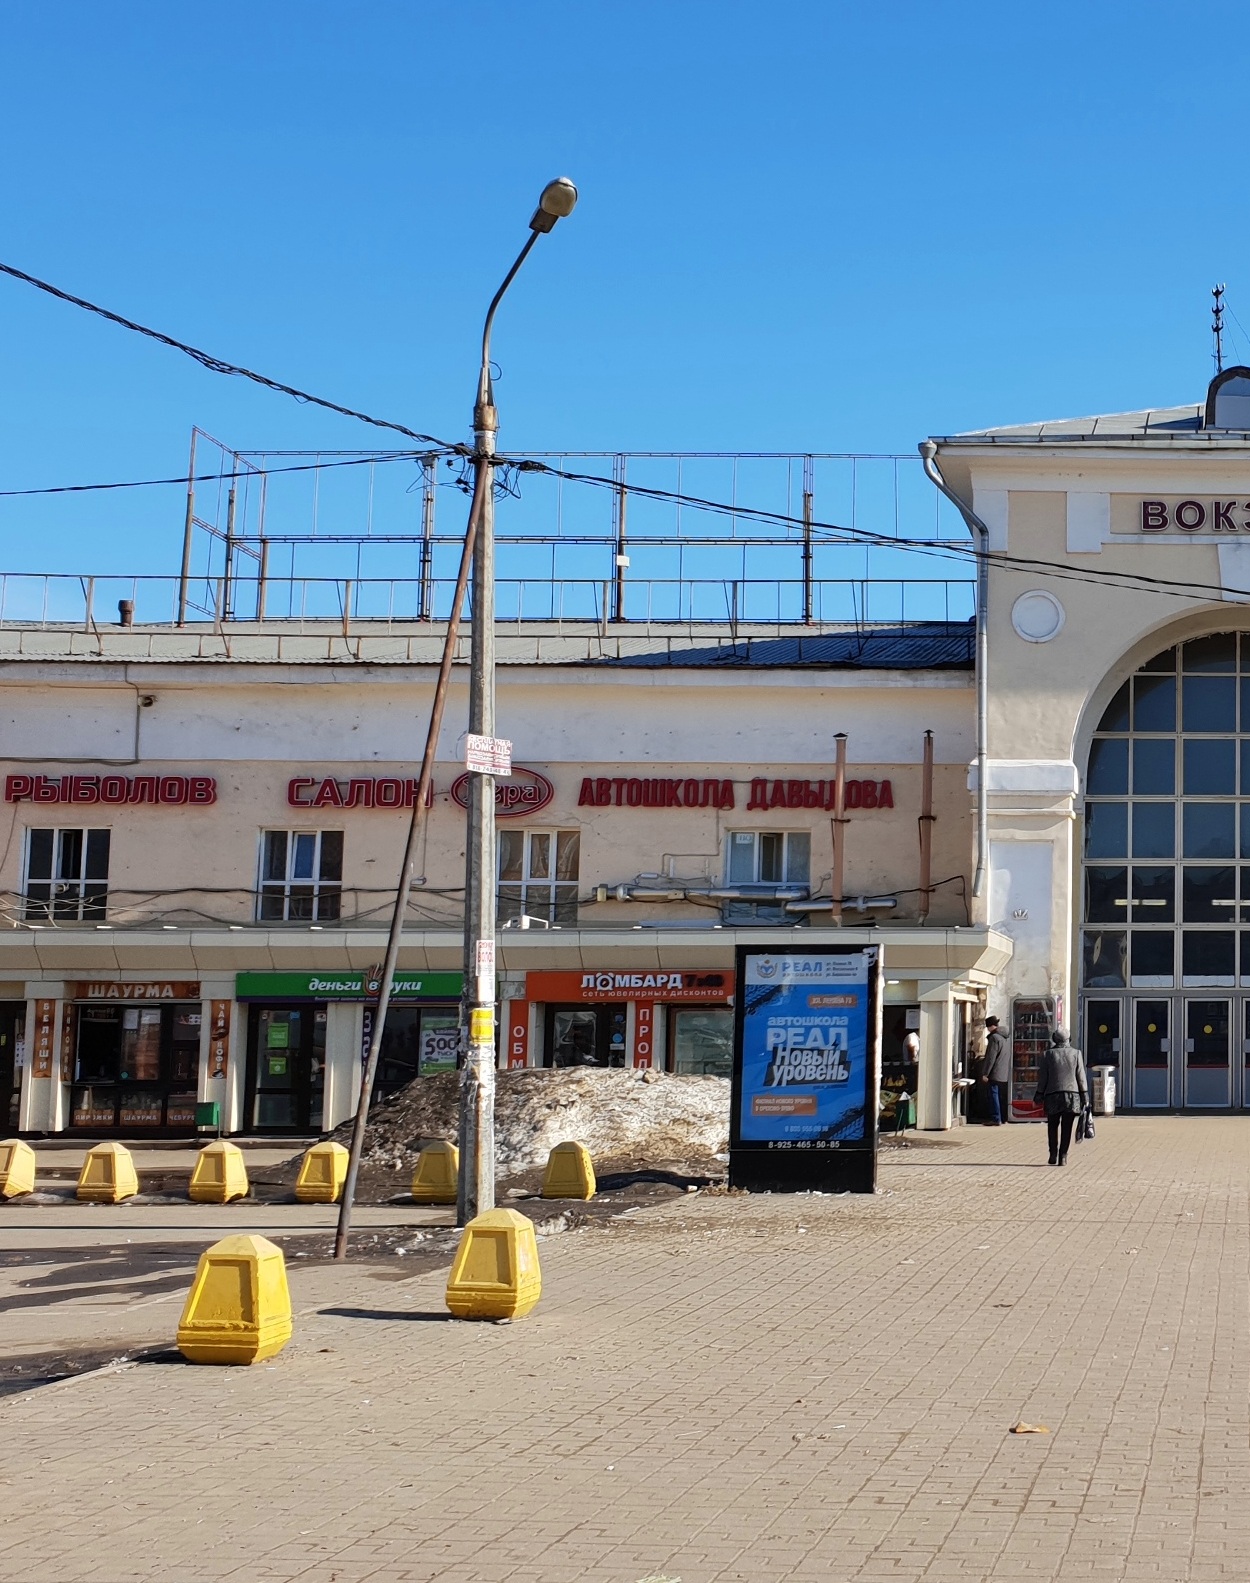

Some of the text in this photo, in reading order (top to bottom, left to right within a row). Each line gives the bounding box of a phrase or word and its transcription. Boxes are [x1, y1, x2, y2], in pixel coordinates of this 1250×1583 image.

[468, 741, 511, 755] ПОМОЩЬ
[4, 774, 217, 805] РЫБОЛОВ
[287, 776, 434, 808] САЛОН
[578, 777, 894, 811] АВТОШКОЛА ДАВЫДОВА
[782, 962, 822, 972] РЕАЛ
[88, 984, 175, 998] ШАУРМА
[308, 978, 422, 994] деньги в уки
[581, 971, 683, 991] ЛОМБАРД
[608, 990, 667, 998] ювелирных
[670, 989, 724, 997] дисконтов
[217, 1003, 225, 1027] ЧАЙ
[767, 1016, 848, 1026] автошкола
[39, 1003, 50, 1069] БЕЛЯШИ
[425, 1037, 458, 1056] 500
[766, 1027, 848, 1051] РЕАЛ
[215, 1041, 224, 1070] КОФЕ
[775, 1044, 840, 1066] Новый
[771, 1064, 849, 1088] уровень
